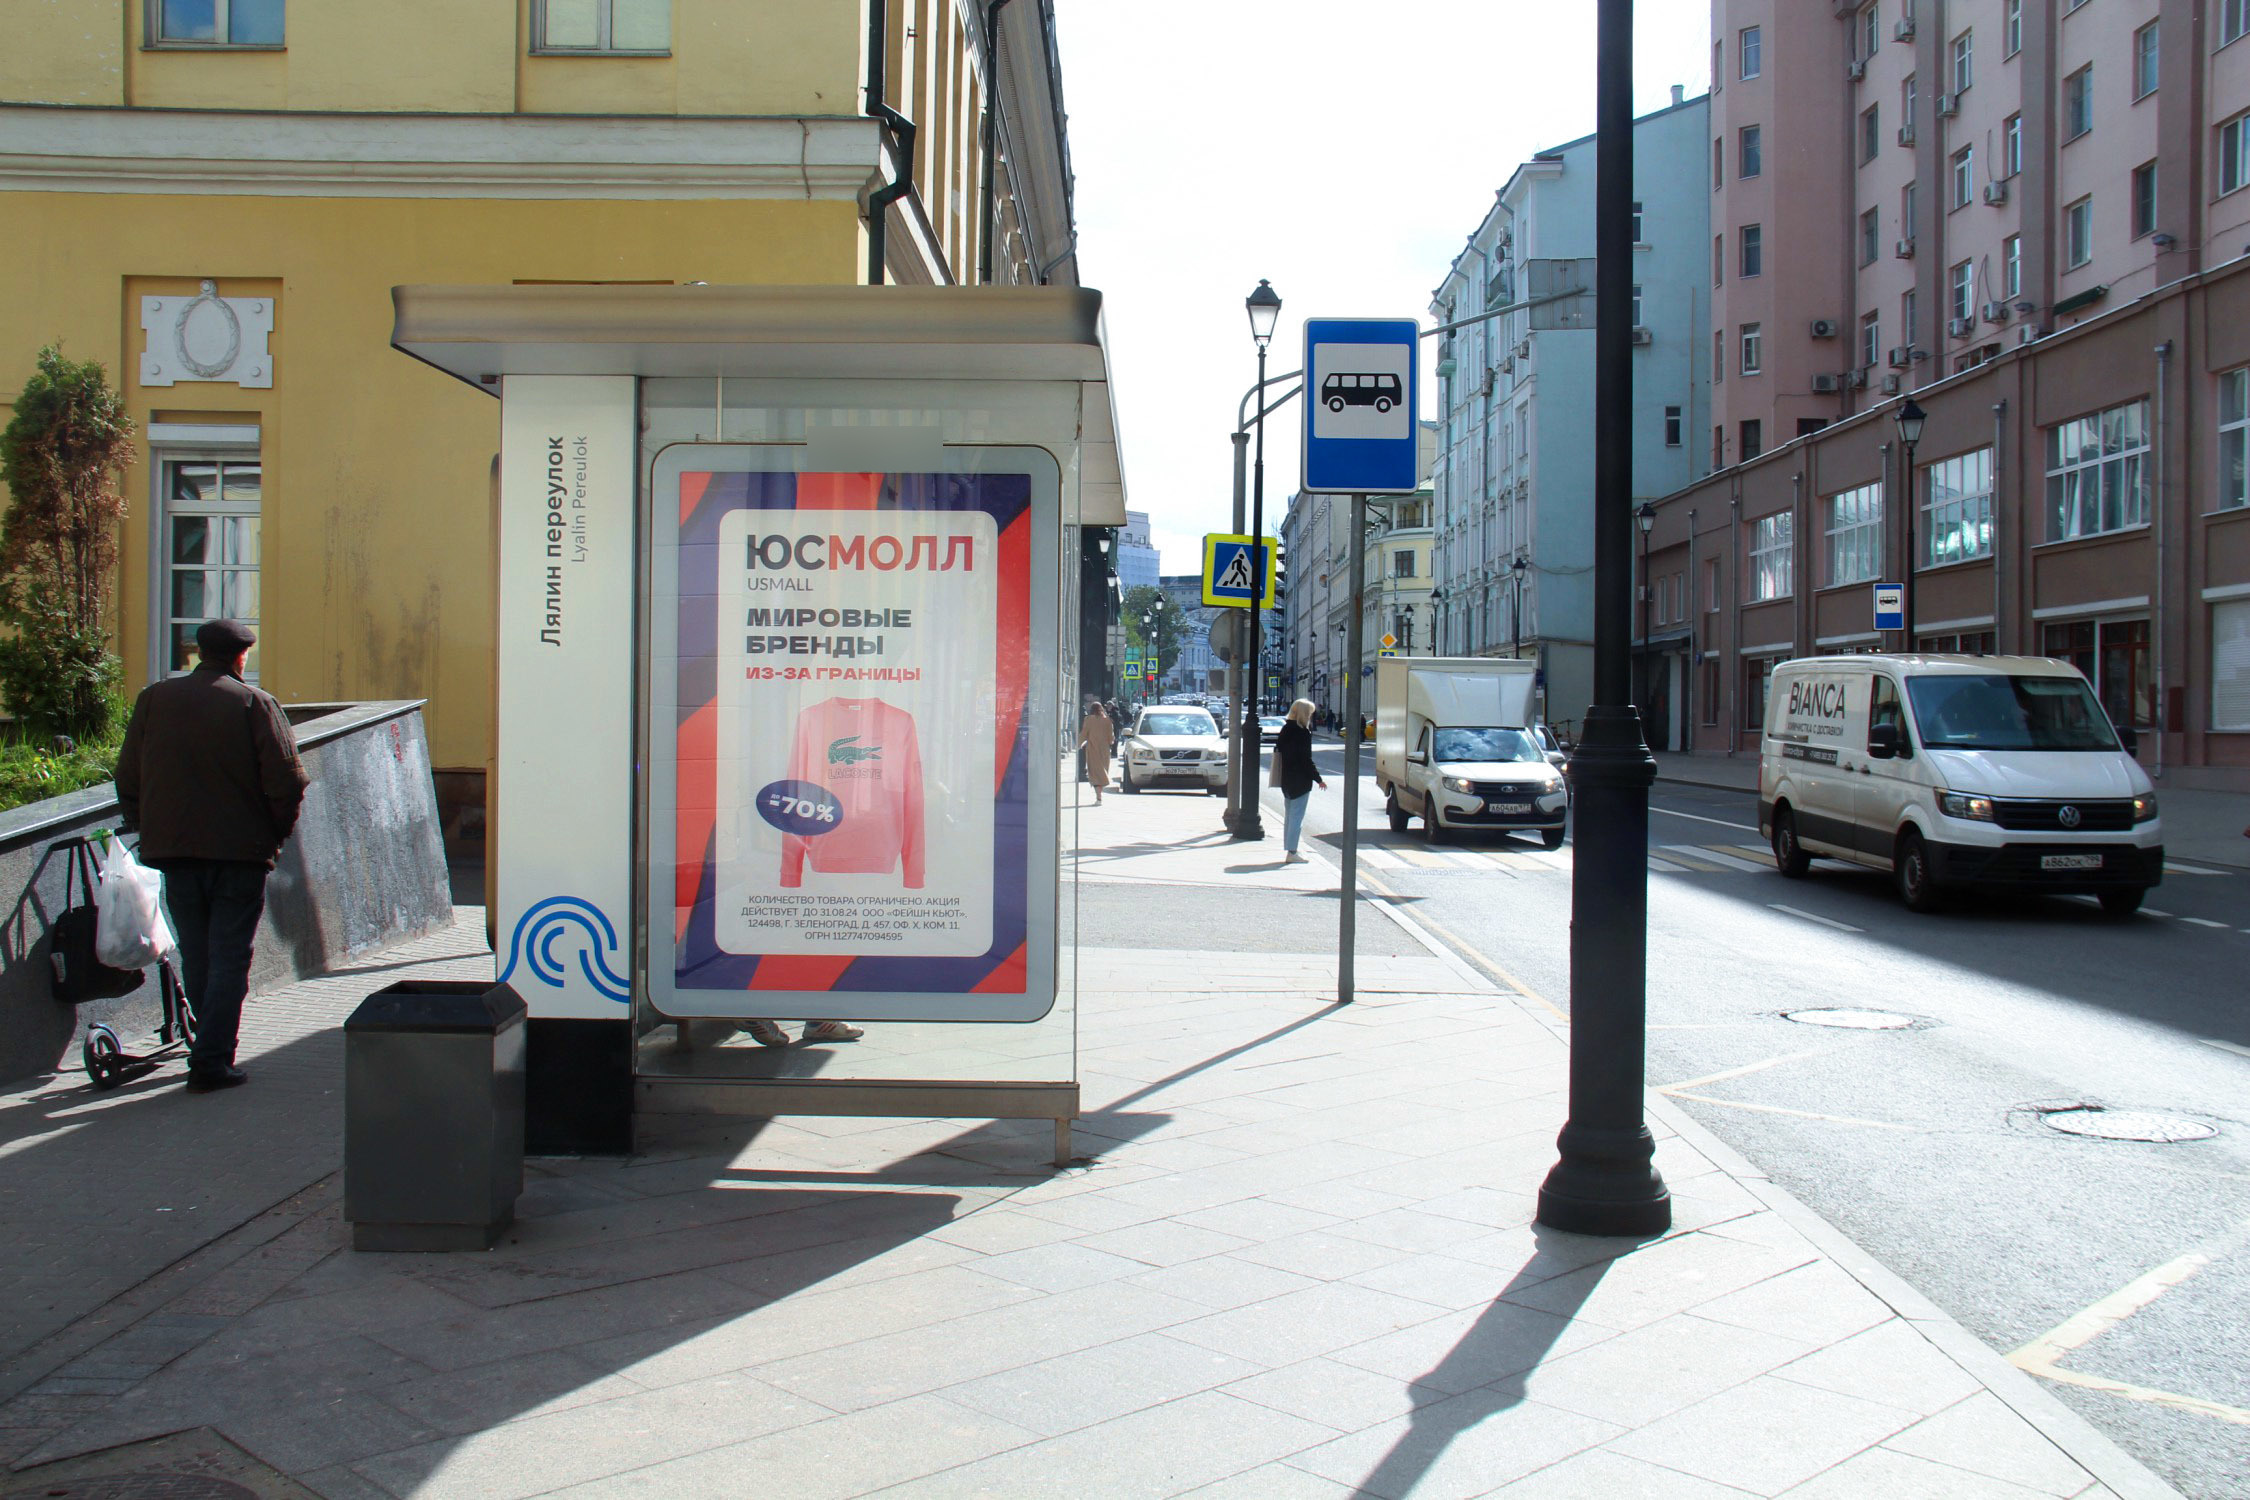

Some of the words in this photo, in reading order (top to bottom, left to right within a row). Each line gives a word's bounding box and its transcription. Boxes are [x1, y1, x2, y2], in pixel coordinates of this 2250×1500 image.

[572, 435, 588, 509] Pereulok
[547, 436, 567, 557] переулок
[571, 514, 589, 563] Lyalin
[747, 534, 974, 571] ЮСМОЛЛ
[747, 577, 814, 592] USMALL
[541, 566, 562, 647] Лялин
[746, 608, 912, 628] МИРОВЫЕ
[746, 635, 884, 658] БРЕНДЫ
[745, 666, 812, 680] ИЗ-ЗА
[816, 667, 921, 683] ГРАНИЦЫ
[1788, 682, 1845, 720] BIANCA
[827, 767, 883, 780] LACOSTE
[769, 795, 835, 823] -70%
[741, 906, 799, 917] ДЕЙСТВУЕТ
[803, 908, 818, 918] ДО
[820, 908, 858, 917] 31.08.24
[862, 908, 885, 917] ООО
[887, 907, 930, 918] «ФЕЙШН
[748, 895, 815, 905] КОЛИЧЕСТВО
[817, 896, 855, 905] ТОВАРА
[925, 897, 960, 907] АКЦИЯ
[805, 931, 831, 940] ОГРН
[832, 931, 903, 942] 1127747094595
